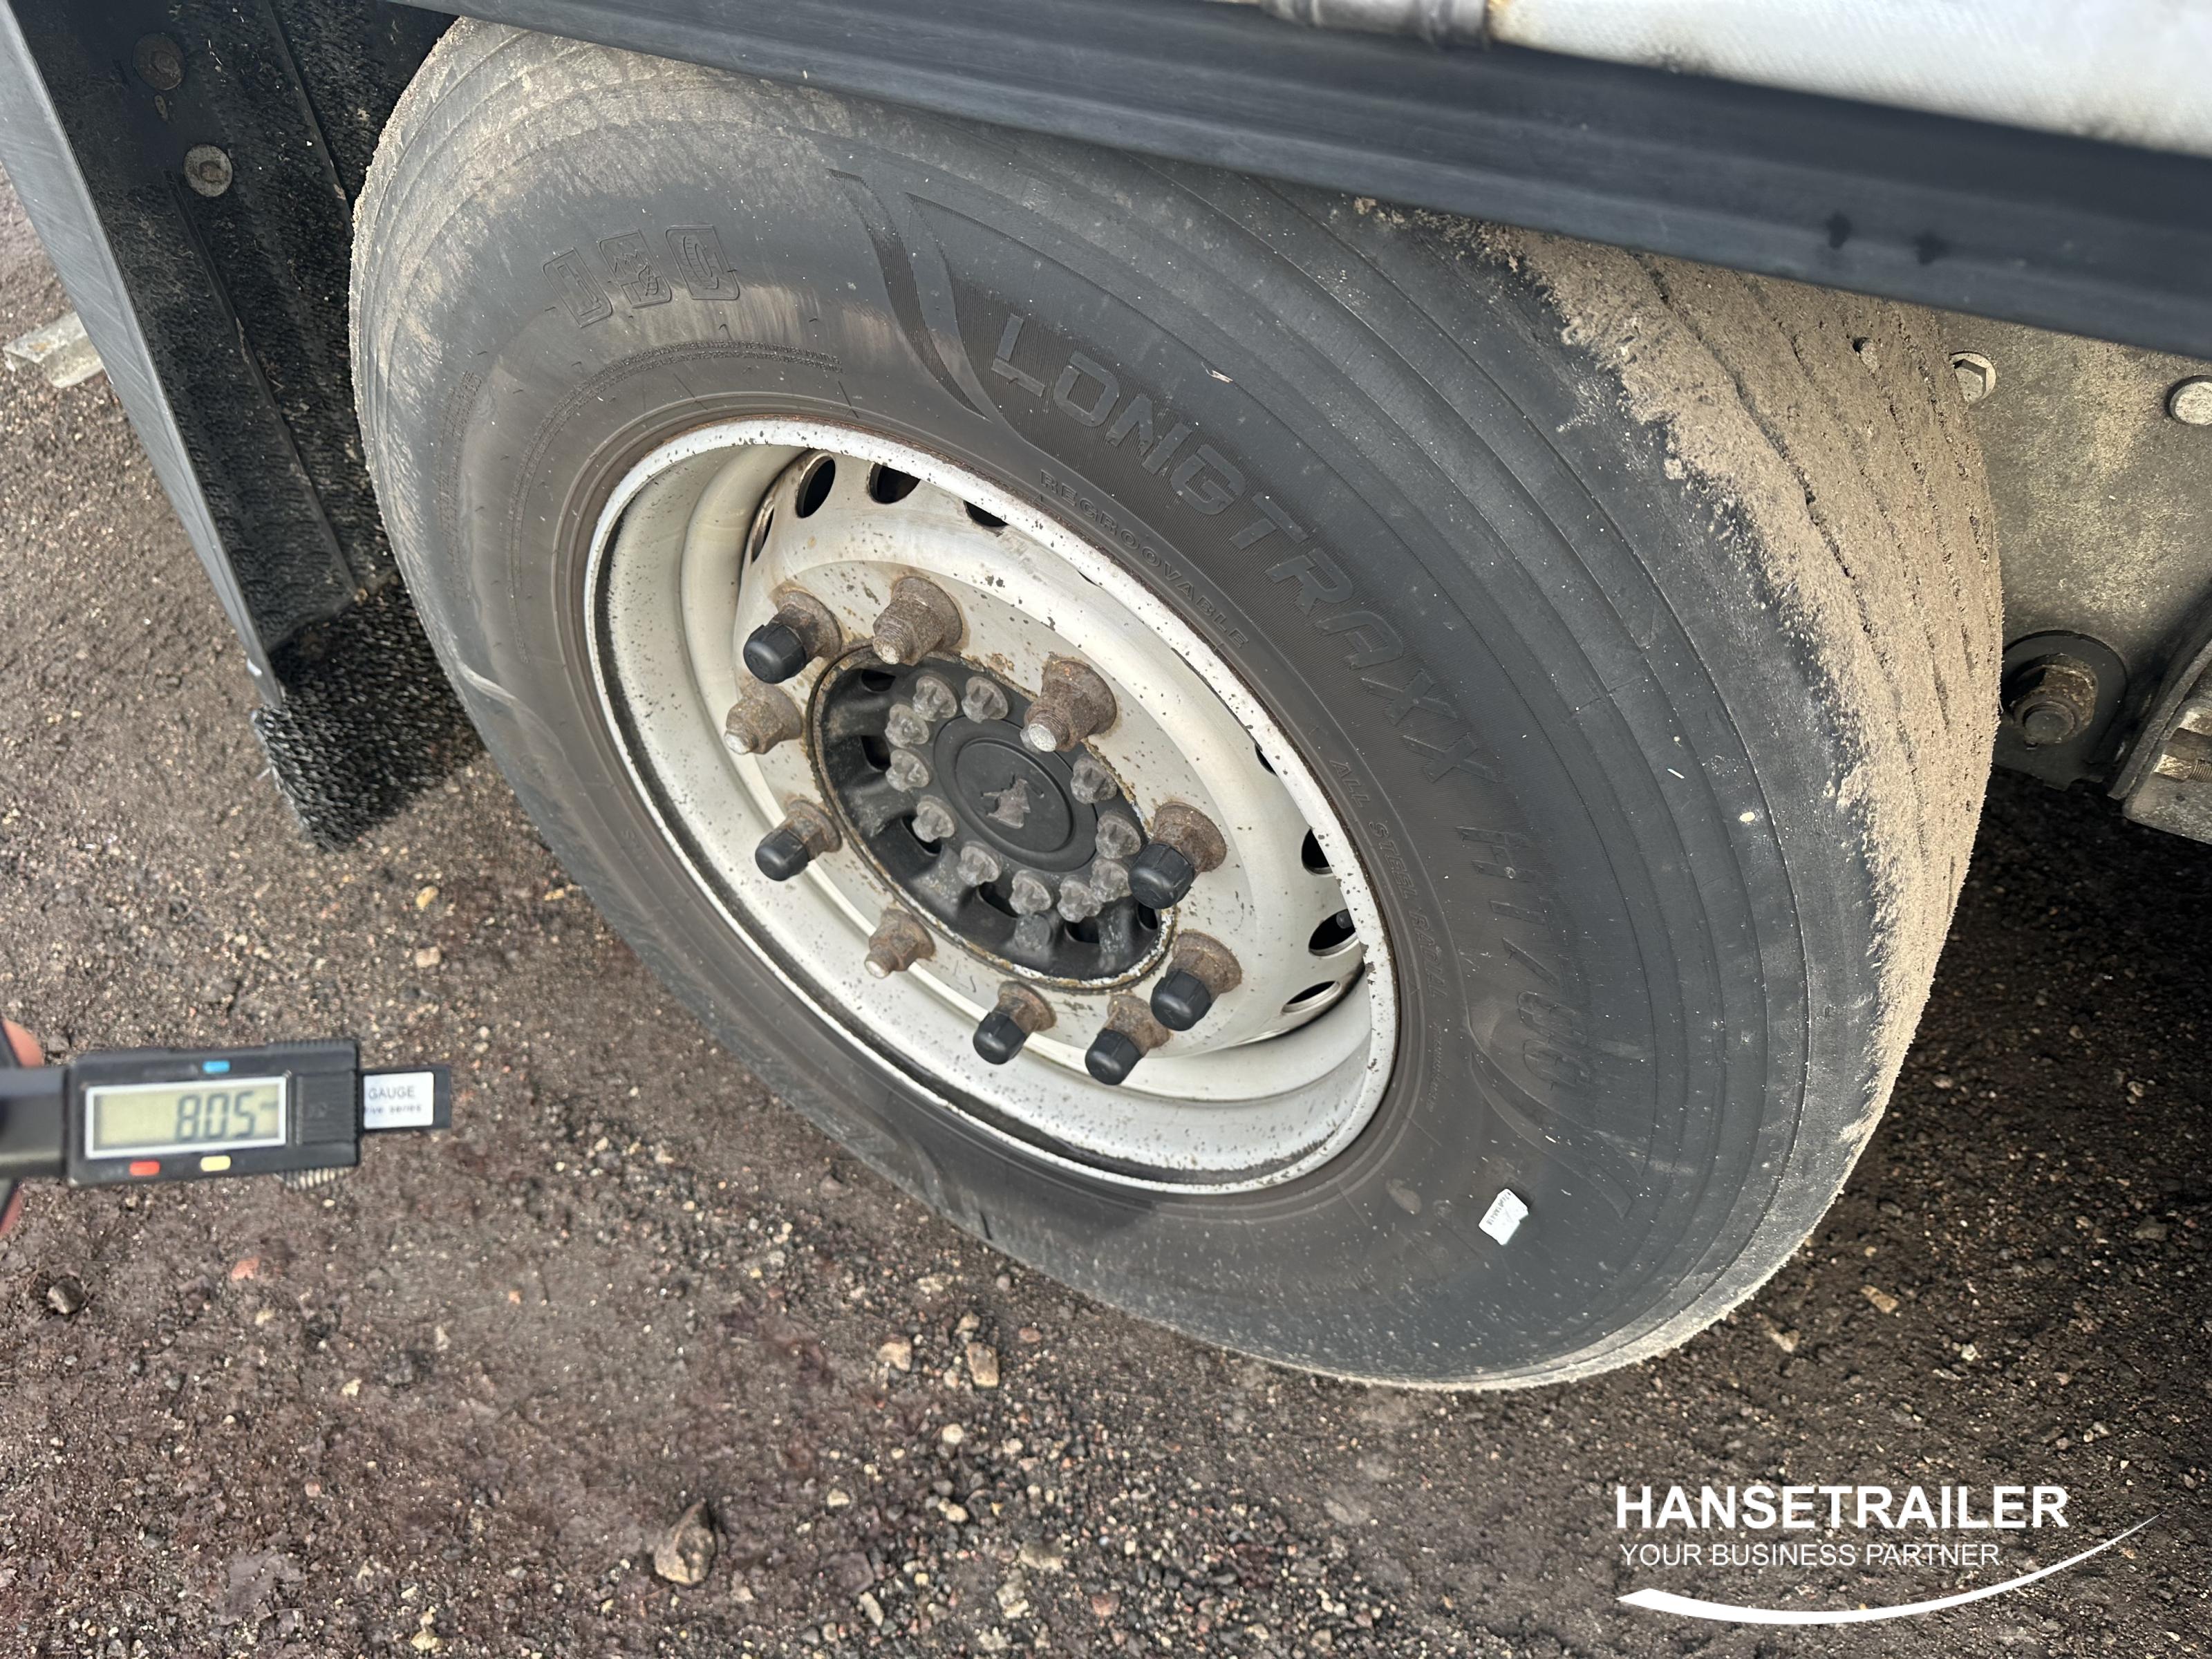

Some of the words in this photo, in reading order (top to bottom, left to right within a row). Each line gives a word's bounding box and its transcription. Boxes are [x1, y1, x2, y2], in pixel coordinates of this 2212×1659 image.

[991, 312, 1503, 784] LONGTRAXX
[1040, 469, 1249, 648] REGROOVABLE
[1332, 761, 1371, 808] ALL
[1368, 821, 1418, 899] STEEL
[1409, 907, 1449, 996] RADIAL
[368, 1085, 416, 1100] GAUGE
